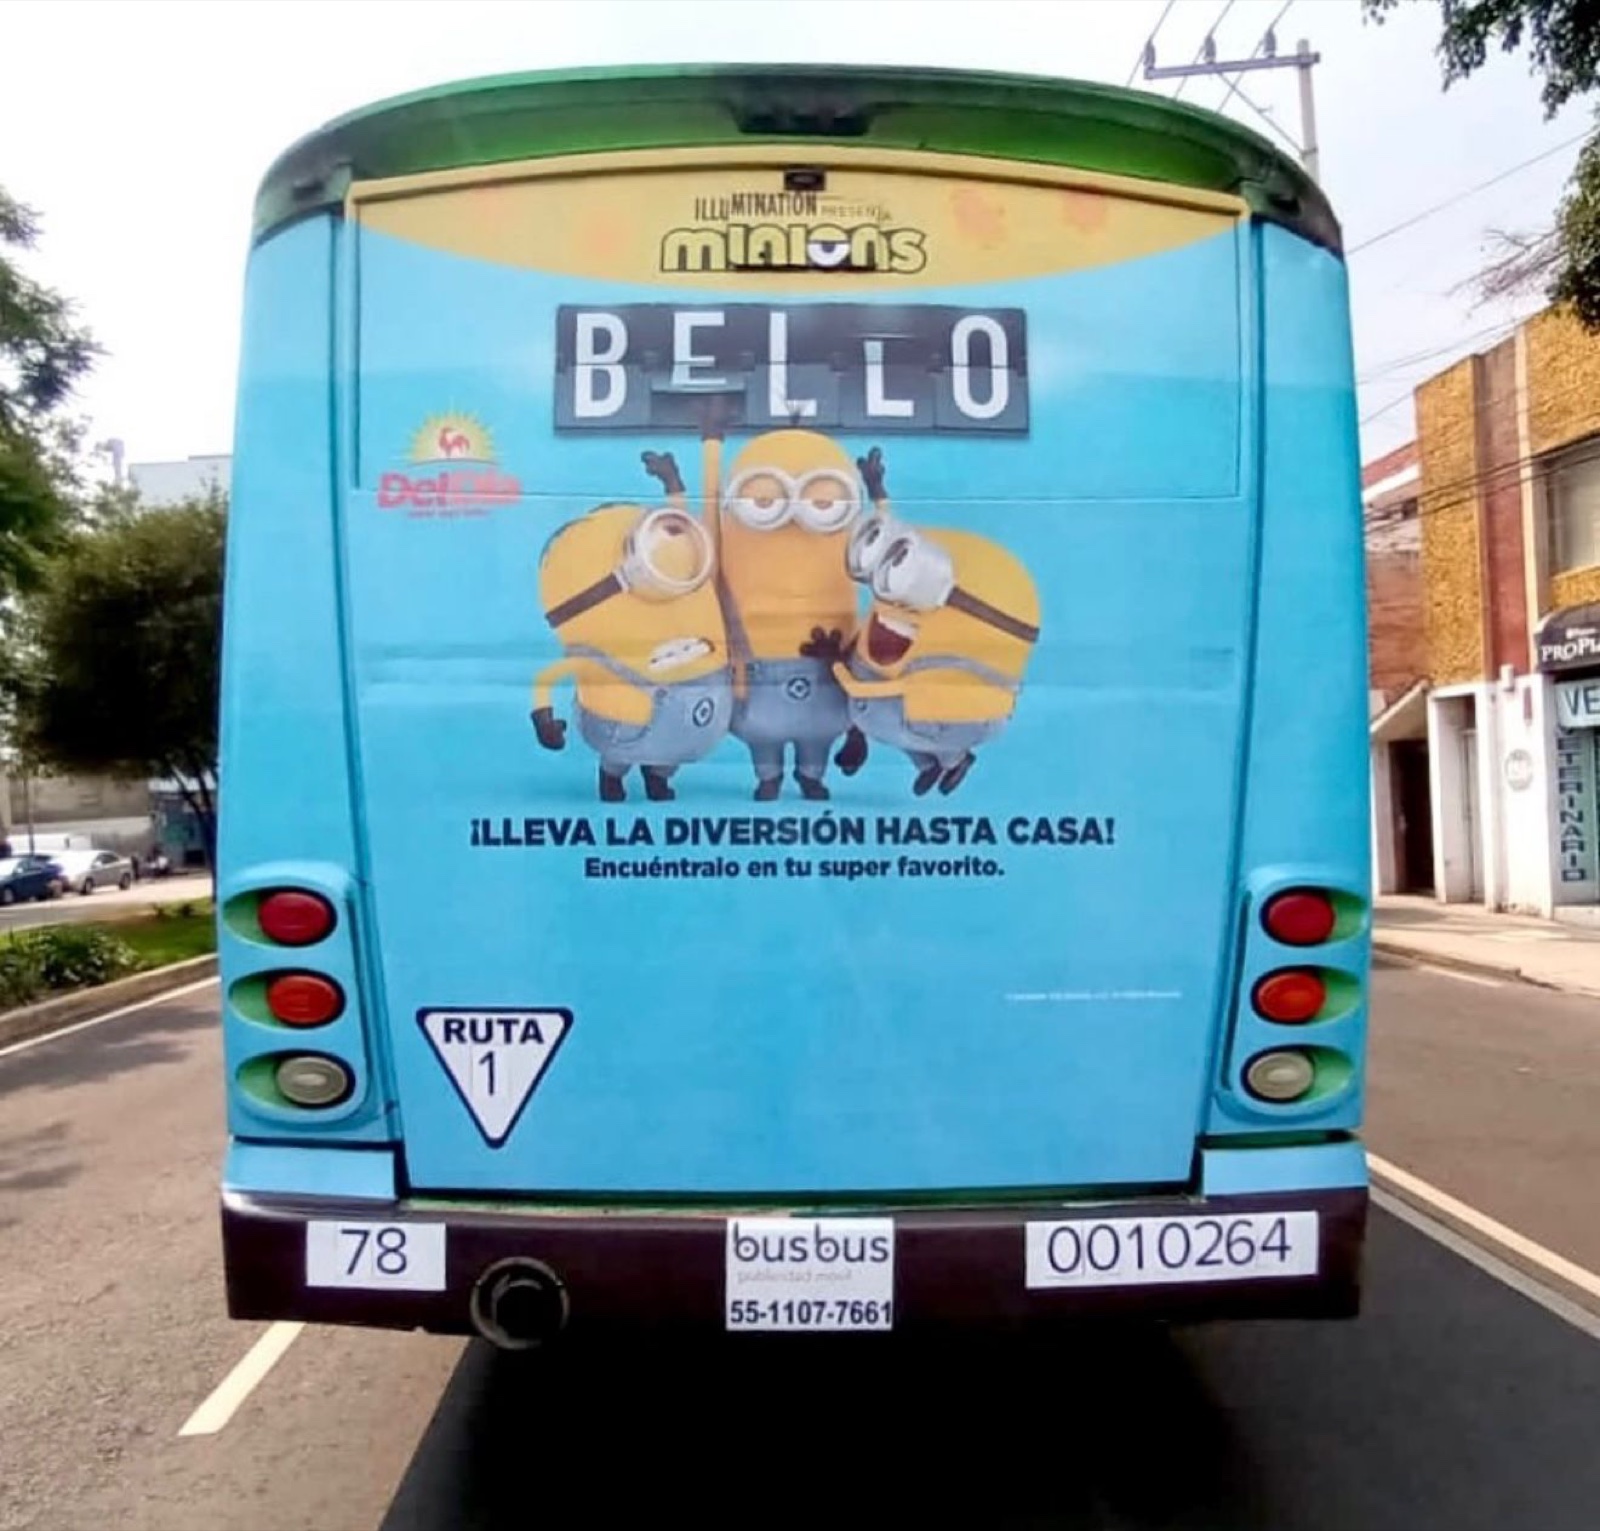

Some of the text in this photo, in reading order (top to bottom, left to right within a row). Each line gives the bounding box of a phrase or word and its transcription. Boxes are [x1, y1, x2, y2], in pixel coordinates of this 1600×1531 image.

[695, 191, 818, 221] ILLUMINATION
[574, 311, 1010, 419] BELLO
[1557, 726, 1587, 882] ETERINARIO
[470, 810, 1115, 846] ¡LLEVA LA DIVERSIÓN HASTA CASA!
[584, 856, 1006, 881] Encuéntralo en tu super favorito.
[444, 1018, 544, 1044] RUTA
[478, 1050, 496, 1097] 1
[341, 1227, 407, 1275] 78
[1048, 1217, 1292, 1273] 0010264
[731, 1301, 892, 1325] 55-1107-7661
